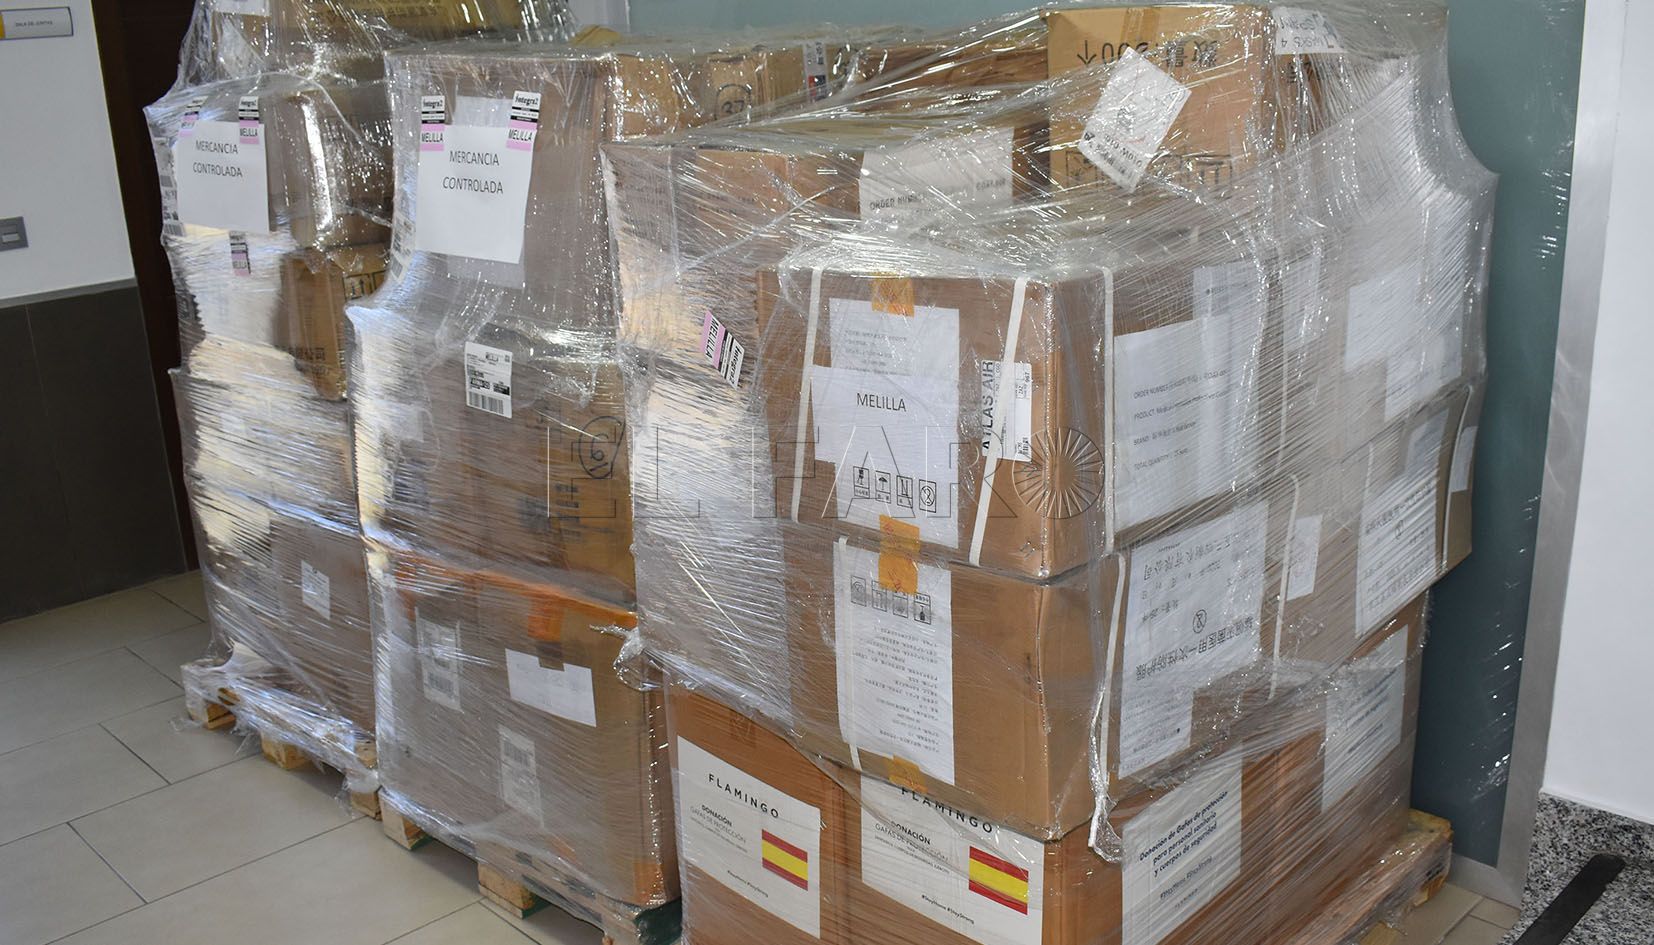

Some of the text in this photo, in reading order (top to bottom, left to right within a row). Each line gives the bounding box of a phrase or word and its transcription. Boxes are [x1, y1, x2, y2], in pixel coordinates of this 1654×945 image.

[240, 127, 258, 137] MELILLA
[421, 132, 444, 143] MELILLA
[508, 129, 533, 142] MELILLA
[195, 140, 239, 154] MERCANCIA
[449, 150, 500, 166] MERCANCIA
[192, 162, 243, 178] CONTROLADA
[442, 176, 504, 194] CONTROLADA
[706, 317, 720, 358] MELILLA
[856, 392, 907, 413] MELILLA
[708, 773, 779, 819] FLAMINGO
[701, 805, 733, 828] DONACIÓN
[901, 787, 993, 834] FLAMINGO
[875, 823, 896, 839] GAFAS
[890, 820, 931, 846] DONACIÓN
[1139, 836, 1168, 861] Donación
[1168, 830, 1176, 841] de
[1176, 818, 1193, 834] Gafas
[1194, 811, 1201, 822] de
[1153, 811, 1217, 865] para personal sanitario
[1159, 851, 1182, 872] cuerpos
[1182, 842, 1190, 854] de
[1190, 822, 1218, 849] seguridad
